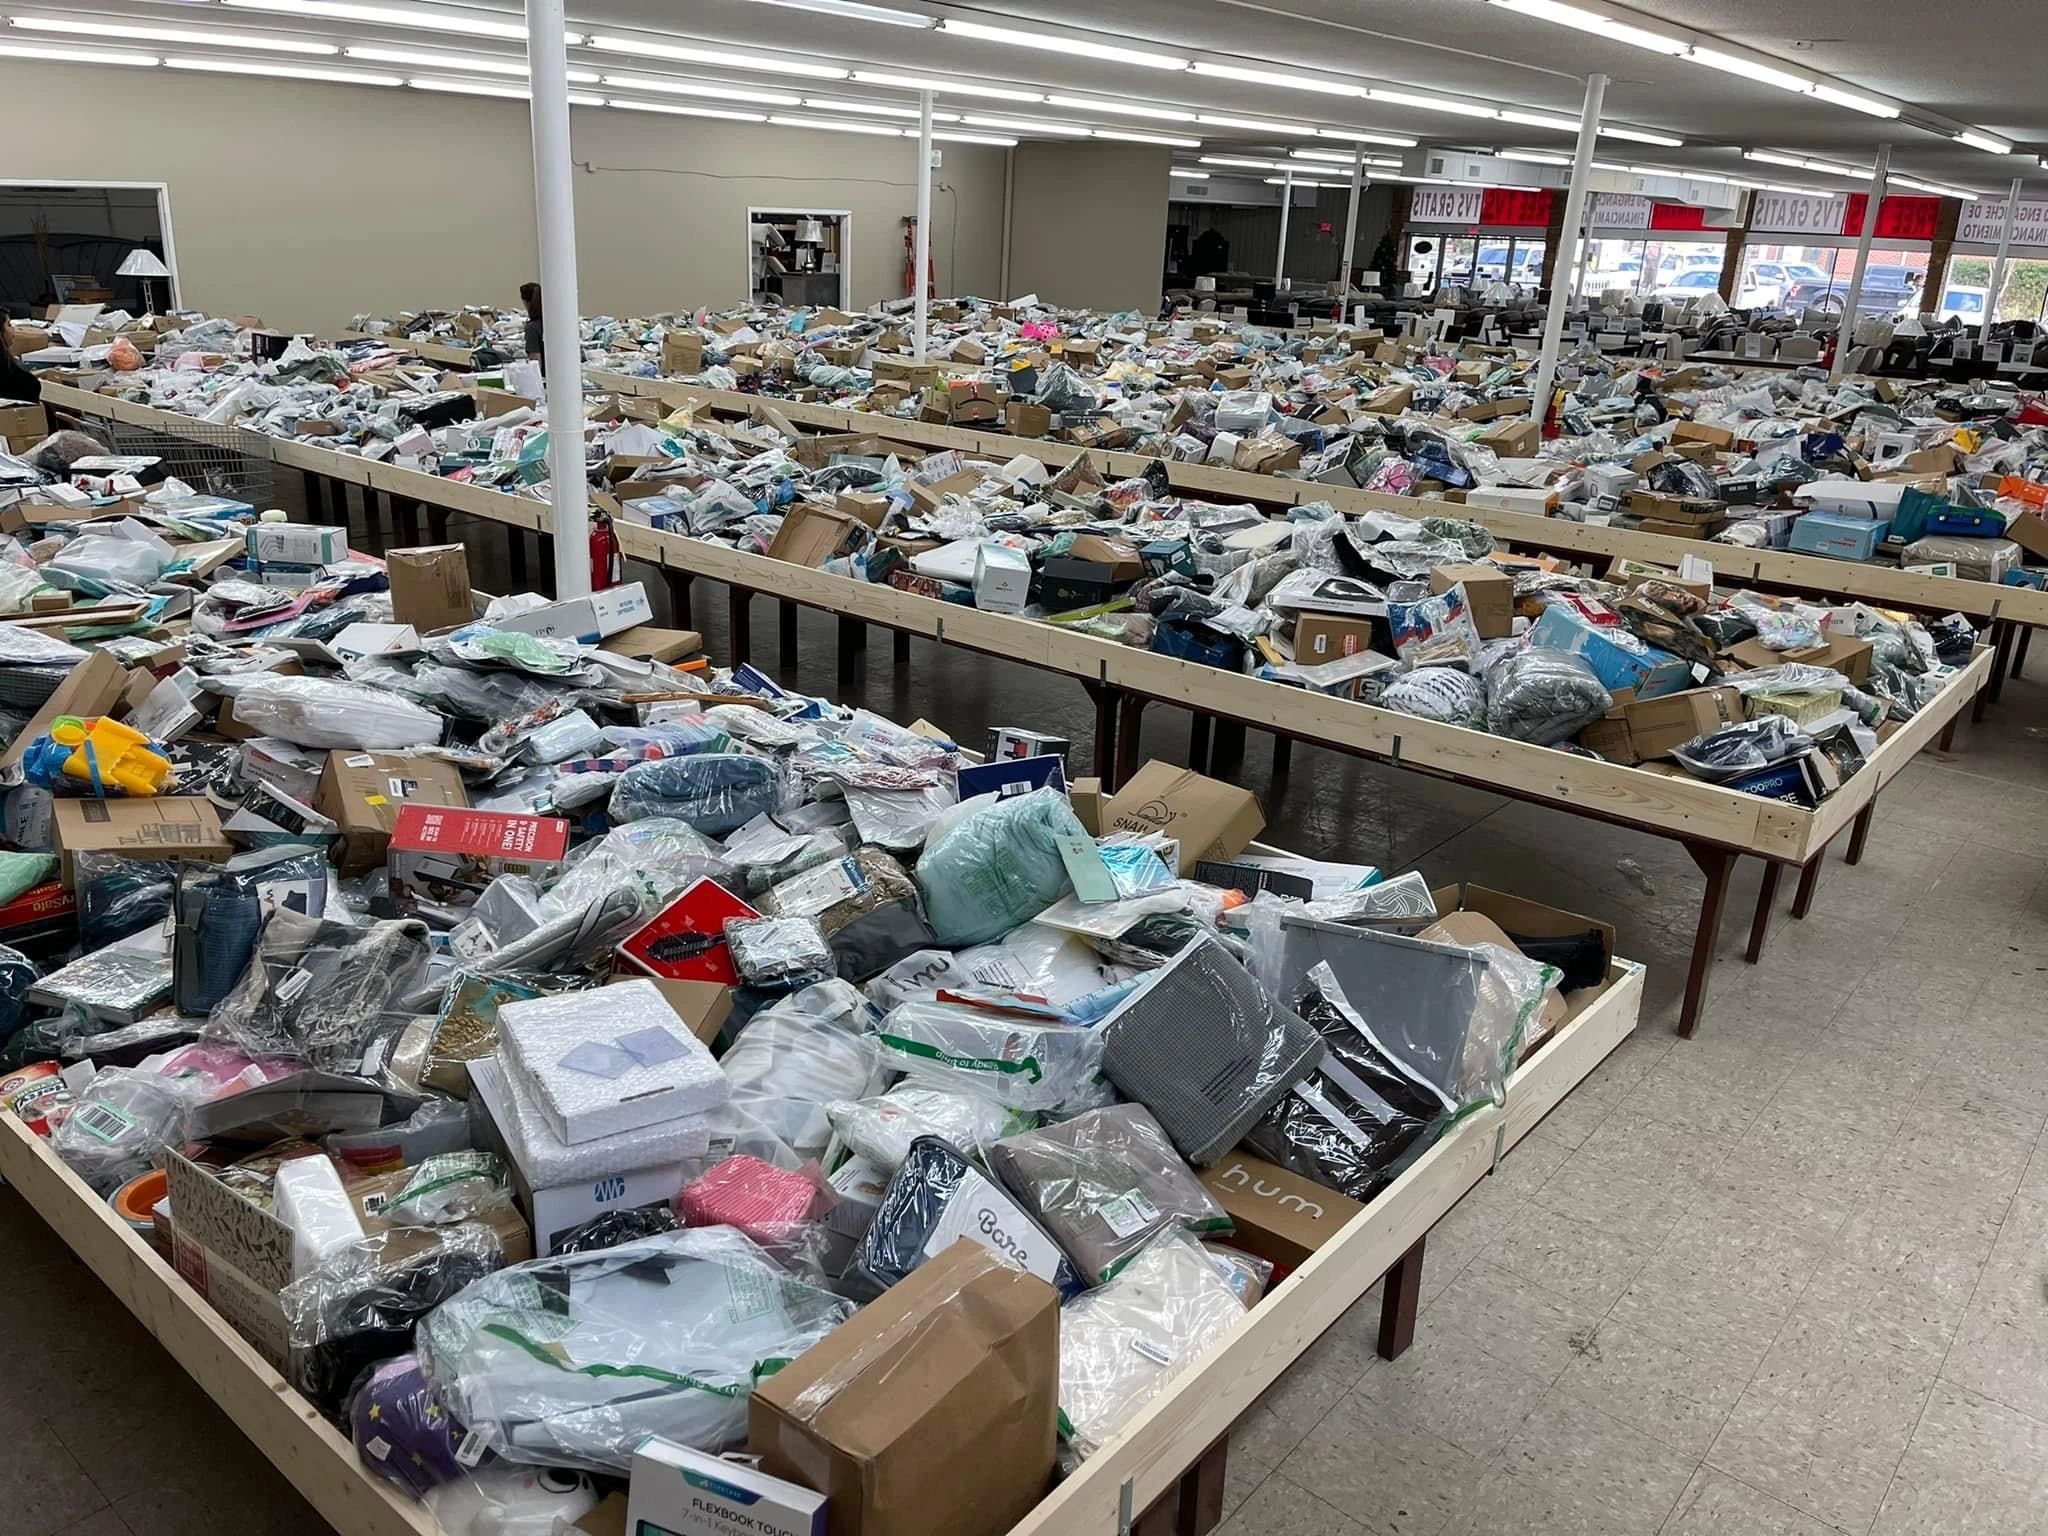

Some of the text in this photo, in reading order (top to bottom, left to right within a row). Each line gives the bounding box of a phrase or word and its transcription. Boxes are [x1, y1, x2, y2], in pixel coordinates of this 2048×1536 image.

[505, 819, 517, 829] IN
[513, 826, 529, 852] SAFETY
[525, 820, 538, 853] PRECISION
[1222, 1163, 1324, 1221] hum
[977, 1207, 1028, 1269] Bare
[692, 1497, 755, 1530] FLEXBOOK
